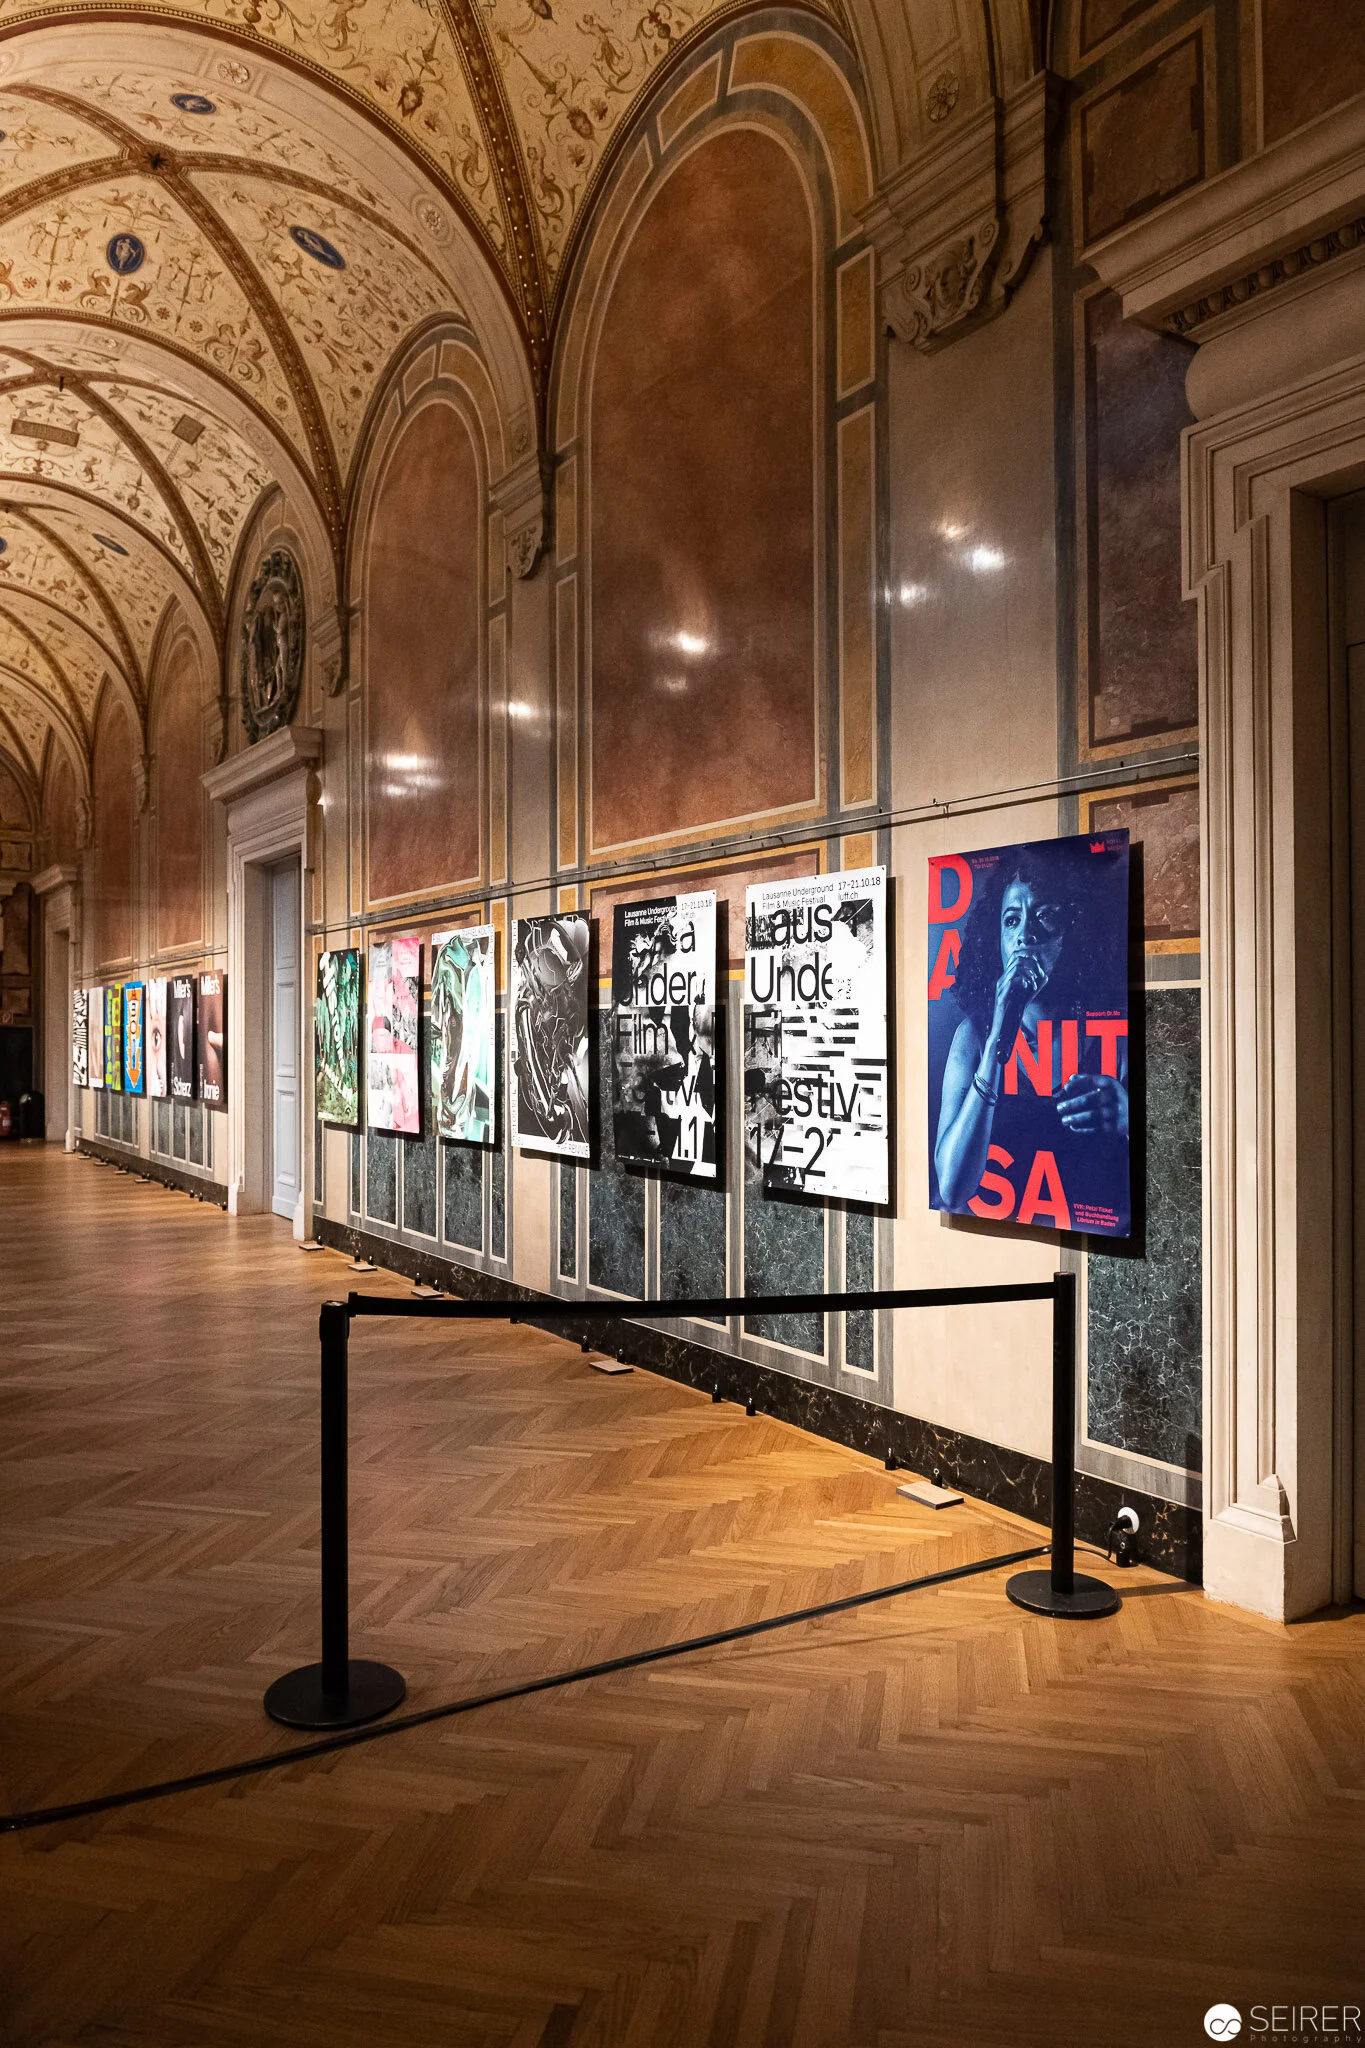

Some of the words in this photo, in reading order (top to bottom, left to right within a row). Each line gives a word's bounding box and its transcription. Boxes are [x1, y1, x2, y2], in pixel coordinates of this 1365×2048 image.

[762, 890, 792, 901] Lausanne
[792, 883, 834, 897] Underground
[838, 876, 881, 891] 17-21.10.18
[763, 901, 776, 910] Film
[783, 898, 800, 908] Music
[801, 895, 826, 906] Festival
[838, 890, 859, 901] luff.ch
[928, 854, 973, 924] D
[624, 909, 647, 919] Lausanne
[624, 919, 634, 927] Film
[634, 918, 640, 926] &
[640, 917, 653, 925] Music
[1004, 1020, 1128, 1096] NIT
[967, 1144, 1072, 1230] SA
